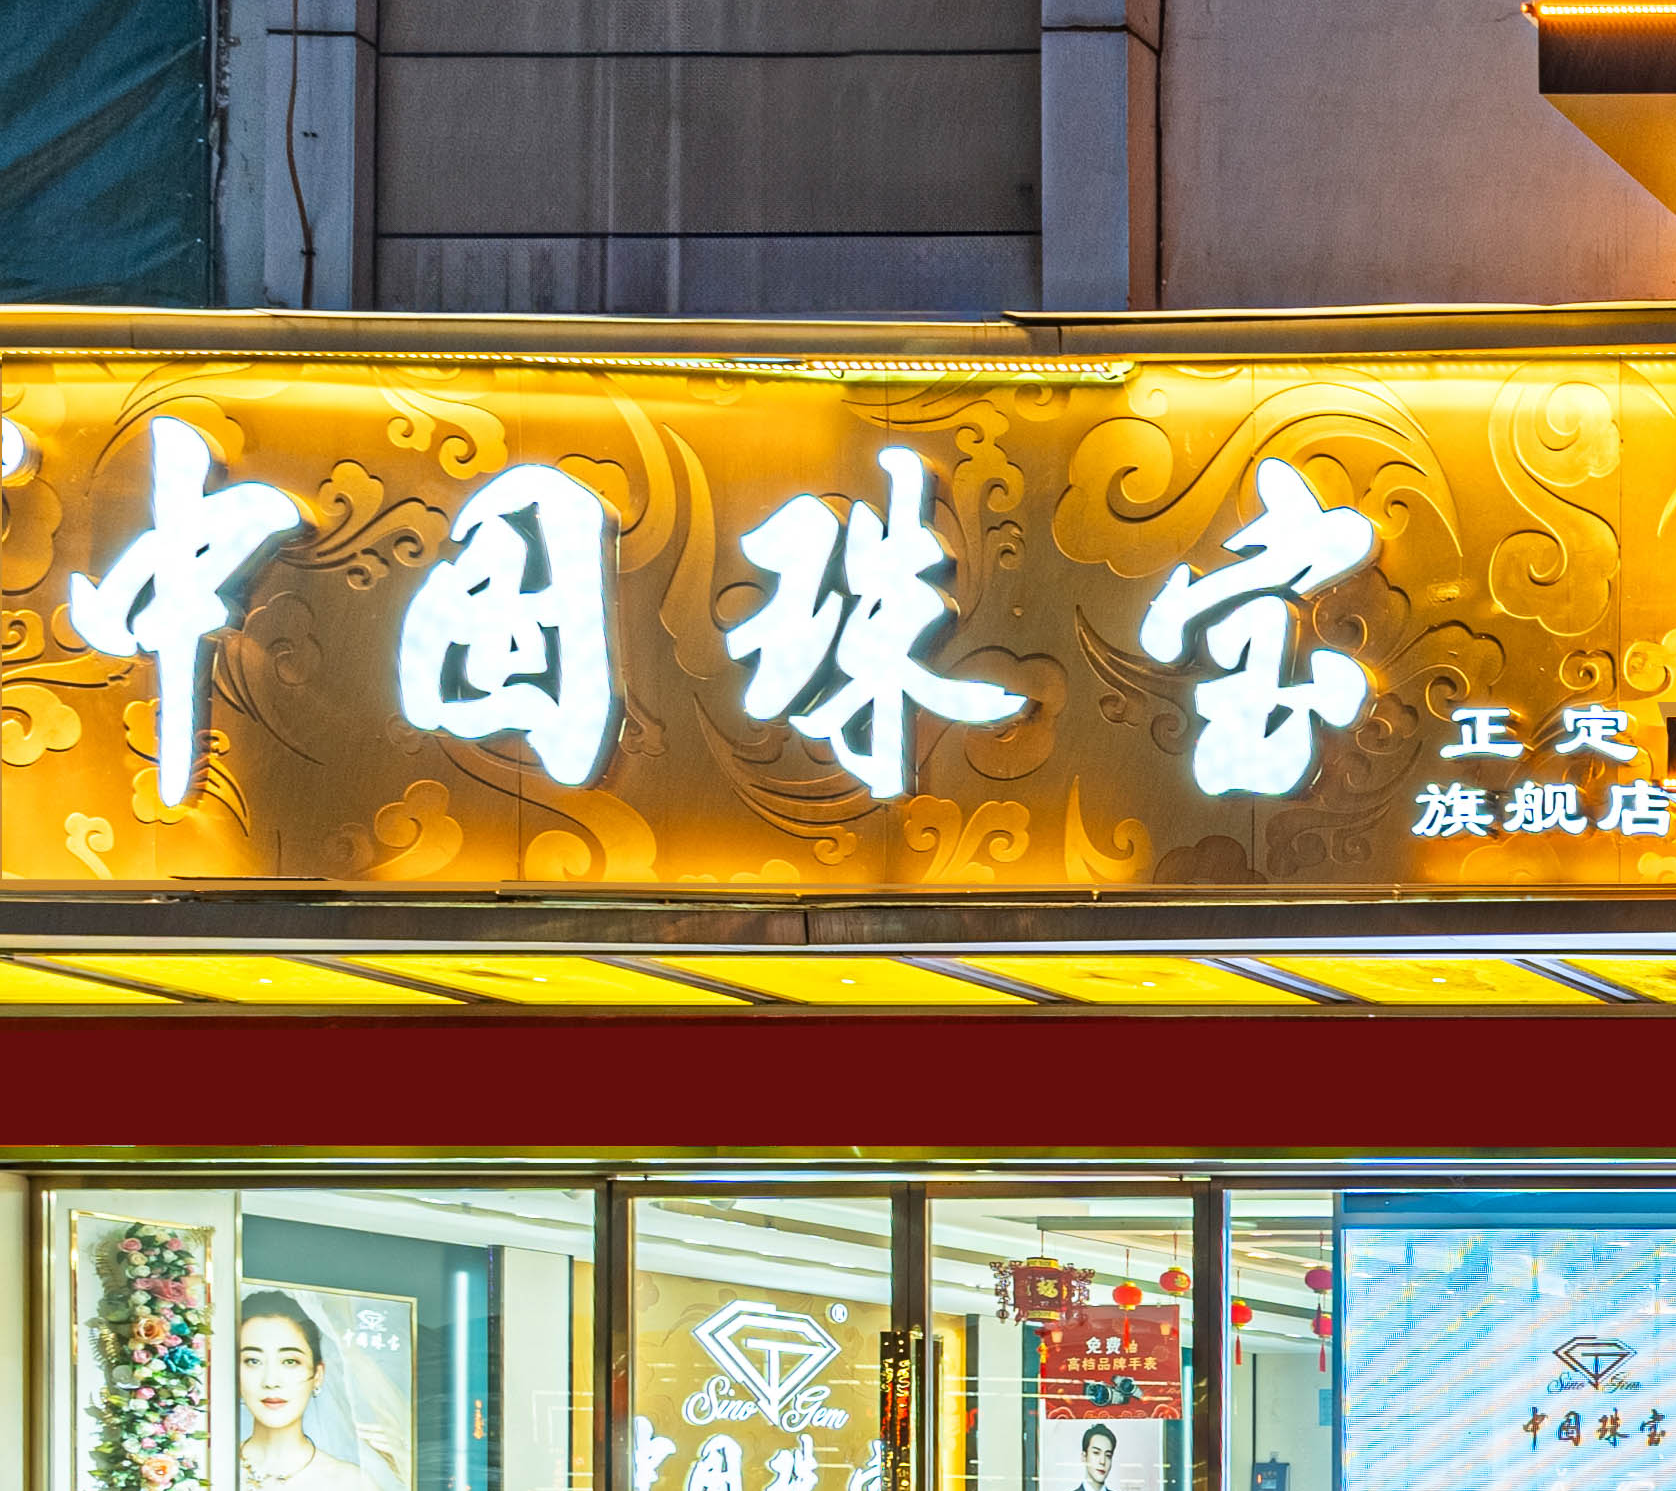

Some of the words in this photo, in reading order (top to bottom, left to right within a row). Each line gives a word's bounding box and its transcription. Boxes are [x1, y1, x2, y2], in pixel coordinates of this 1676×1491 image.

[70, 415, 1375, 807] 中国珠宝
[1439, 704, 1639, 762] 正定
[1410, 778, 1671, 837] 旗舰店
[1067, 1357, 1158, 1371] 高档品牌手表
[682, 1375, 759, 1425] Sino
[780, 1385, 850, 1433] Gem
[1523, 1406, 1667, 1452] 中国珠宝
